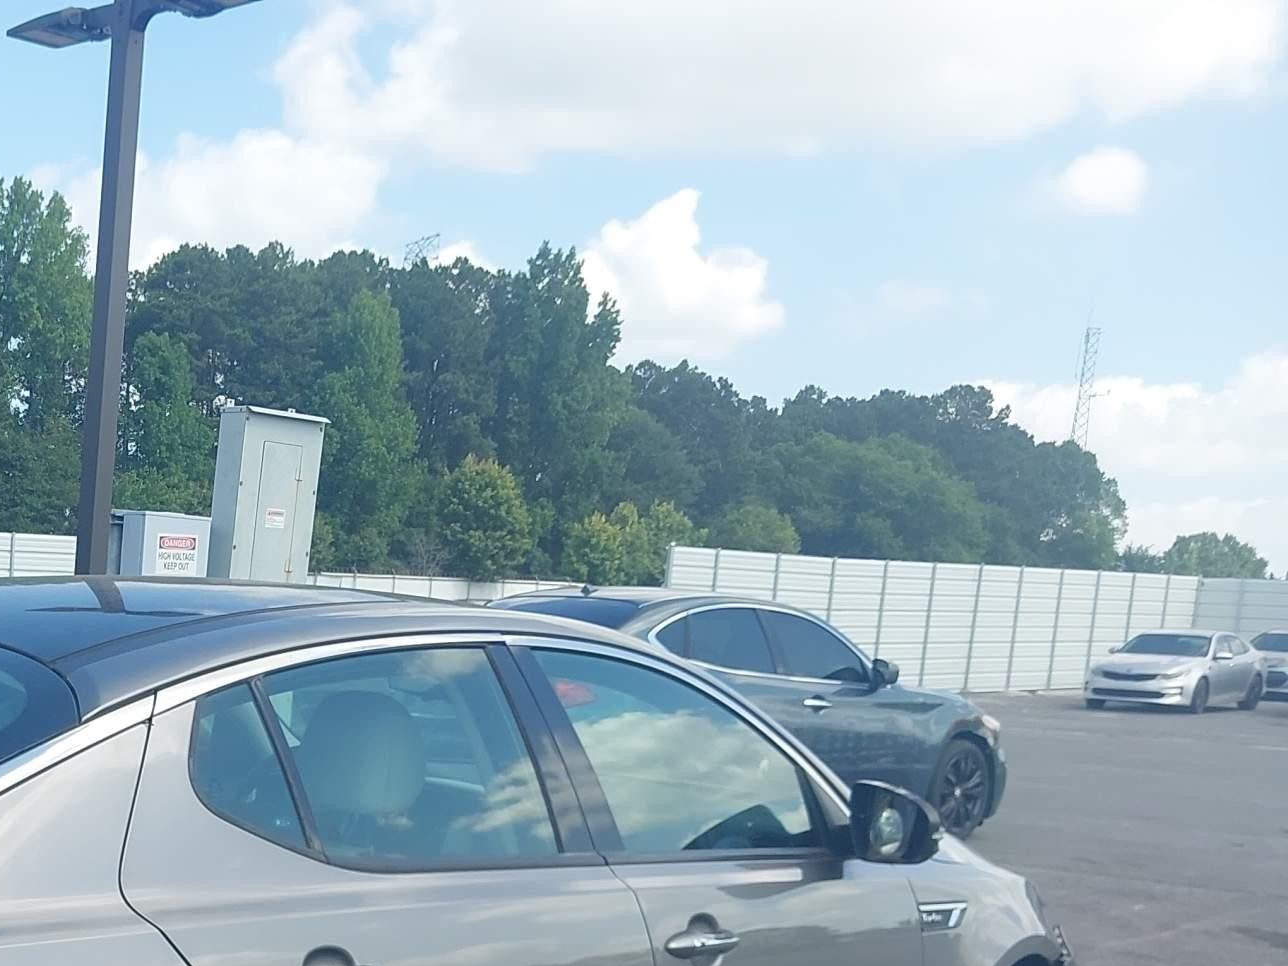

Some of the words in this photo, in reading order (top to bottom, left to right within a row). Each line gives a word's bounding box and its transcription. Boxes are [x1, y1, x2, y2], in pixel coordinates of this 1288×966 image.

[164, 538, 191, 547] DANGER
[158, 551, 171, 560] HIGH
[172, 552, 196, 561] VOLTAGE
[163, 561, 177, 570] KEEP
[178, 562, 190, 570] OUT
